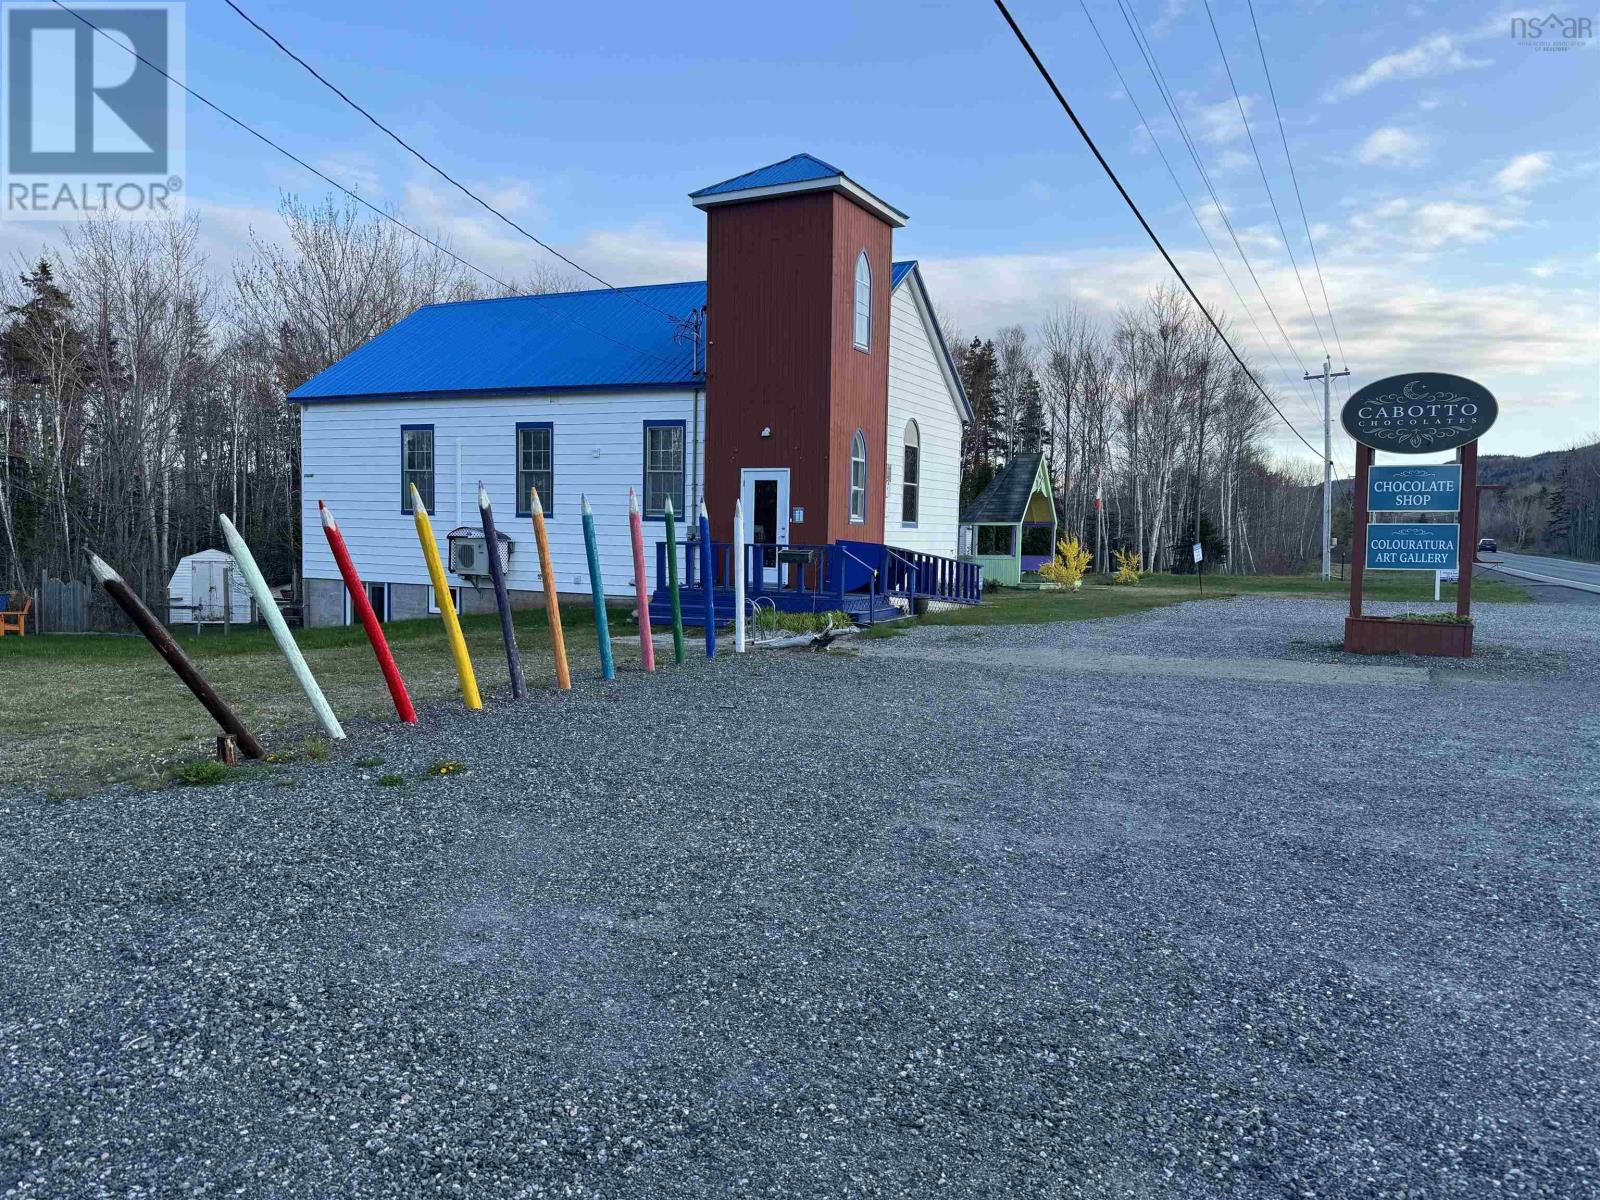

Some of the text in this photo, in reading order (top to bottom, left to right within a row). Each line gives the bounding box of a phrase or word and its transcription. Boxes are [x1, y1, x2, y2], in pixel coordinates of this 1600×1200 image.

[1358, 403, 1478, 419] CABOTTO
[1358, 417, 1477, 427] CHOCOLATES
[1374, 480, 1454, 493] CHOCOLATE
[1395, 494, 1431, 506] SHOP
[1371, 539, 1454, 550] COLOURATURA
[1375, 552, 1449, 563] ART GALLERY
